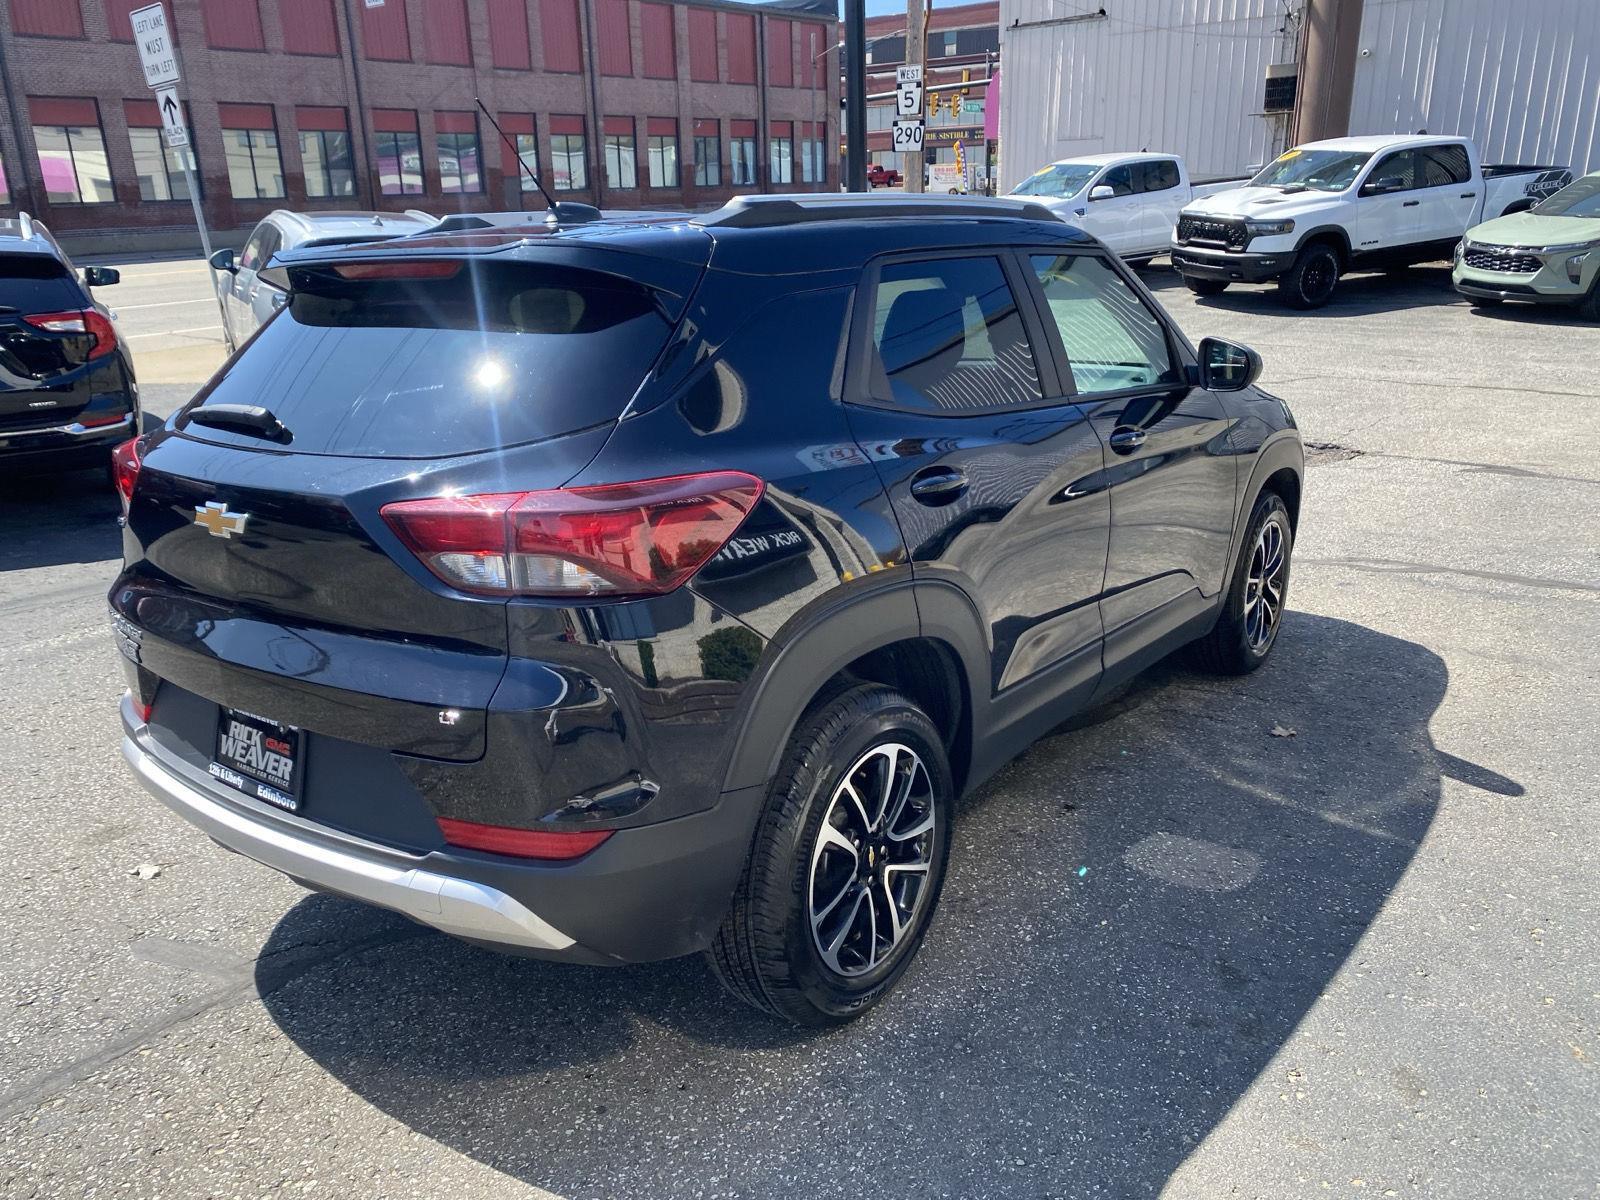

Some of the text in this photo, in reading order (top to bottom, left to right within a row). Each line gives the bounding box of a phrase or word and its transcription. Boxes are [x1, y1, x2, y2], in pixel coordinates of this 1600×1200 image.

[136, 14, 163, 34] LEFT LANE
[145, 37, 164, 55] MUST
[146, 59, 175, 77] TURN LEFT
[900, 68, 919, 79] WEST
[904, 91, 914, 108] 5
[895, 127, 922, 144] 290
[1524, 179, 1565, 194] REBEL
[229, 720, 263, 746] RICK
[266, 737, 290, 755] GMC
[220, 734, 293, 781] WEAVER
[268, 774, 289, 788] SERVICE
[257, 785, 297, 810] Edinboro
